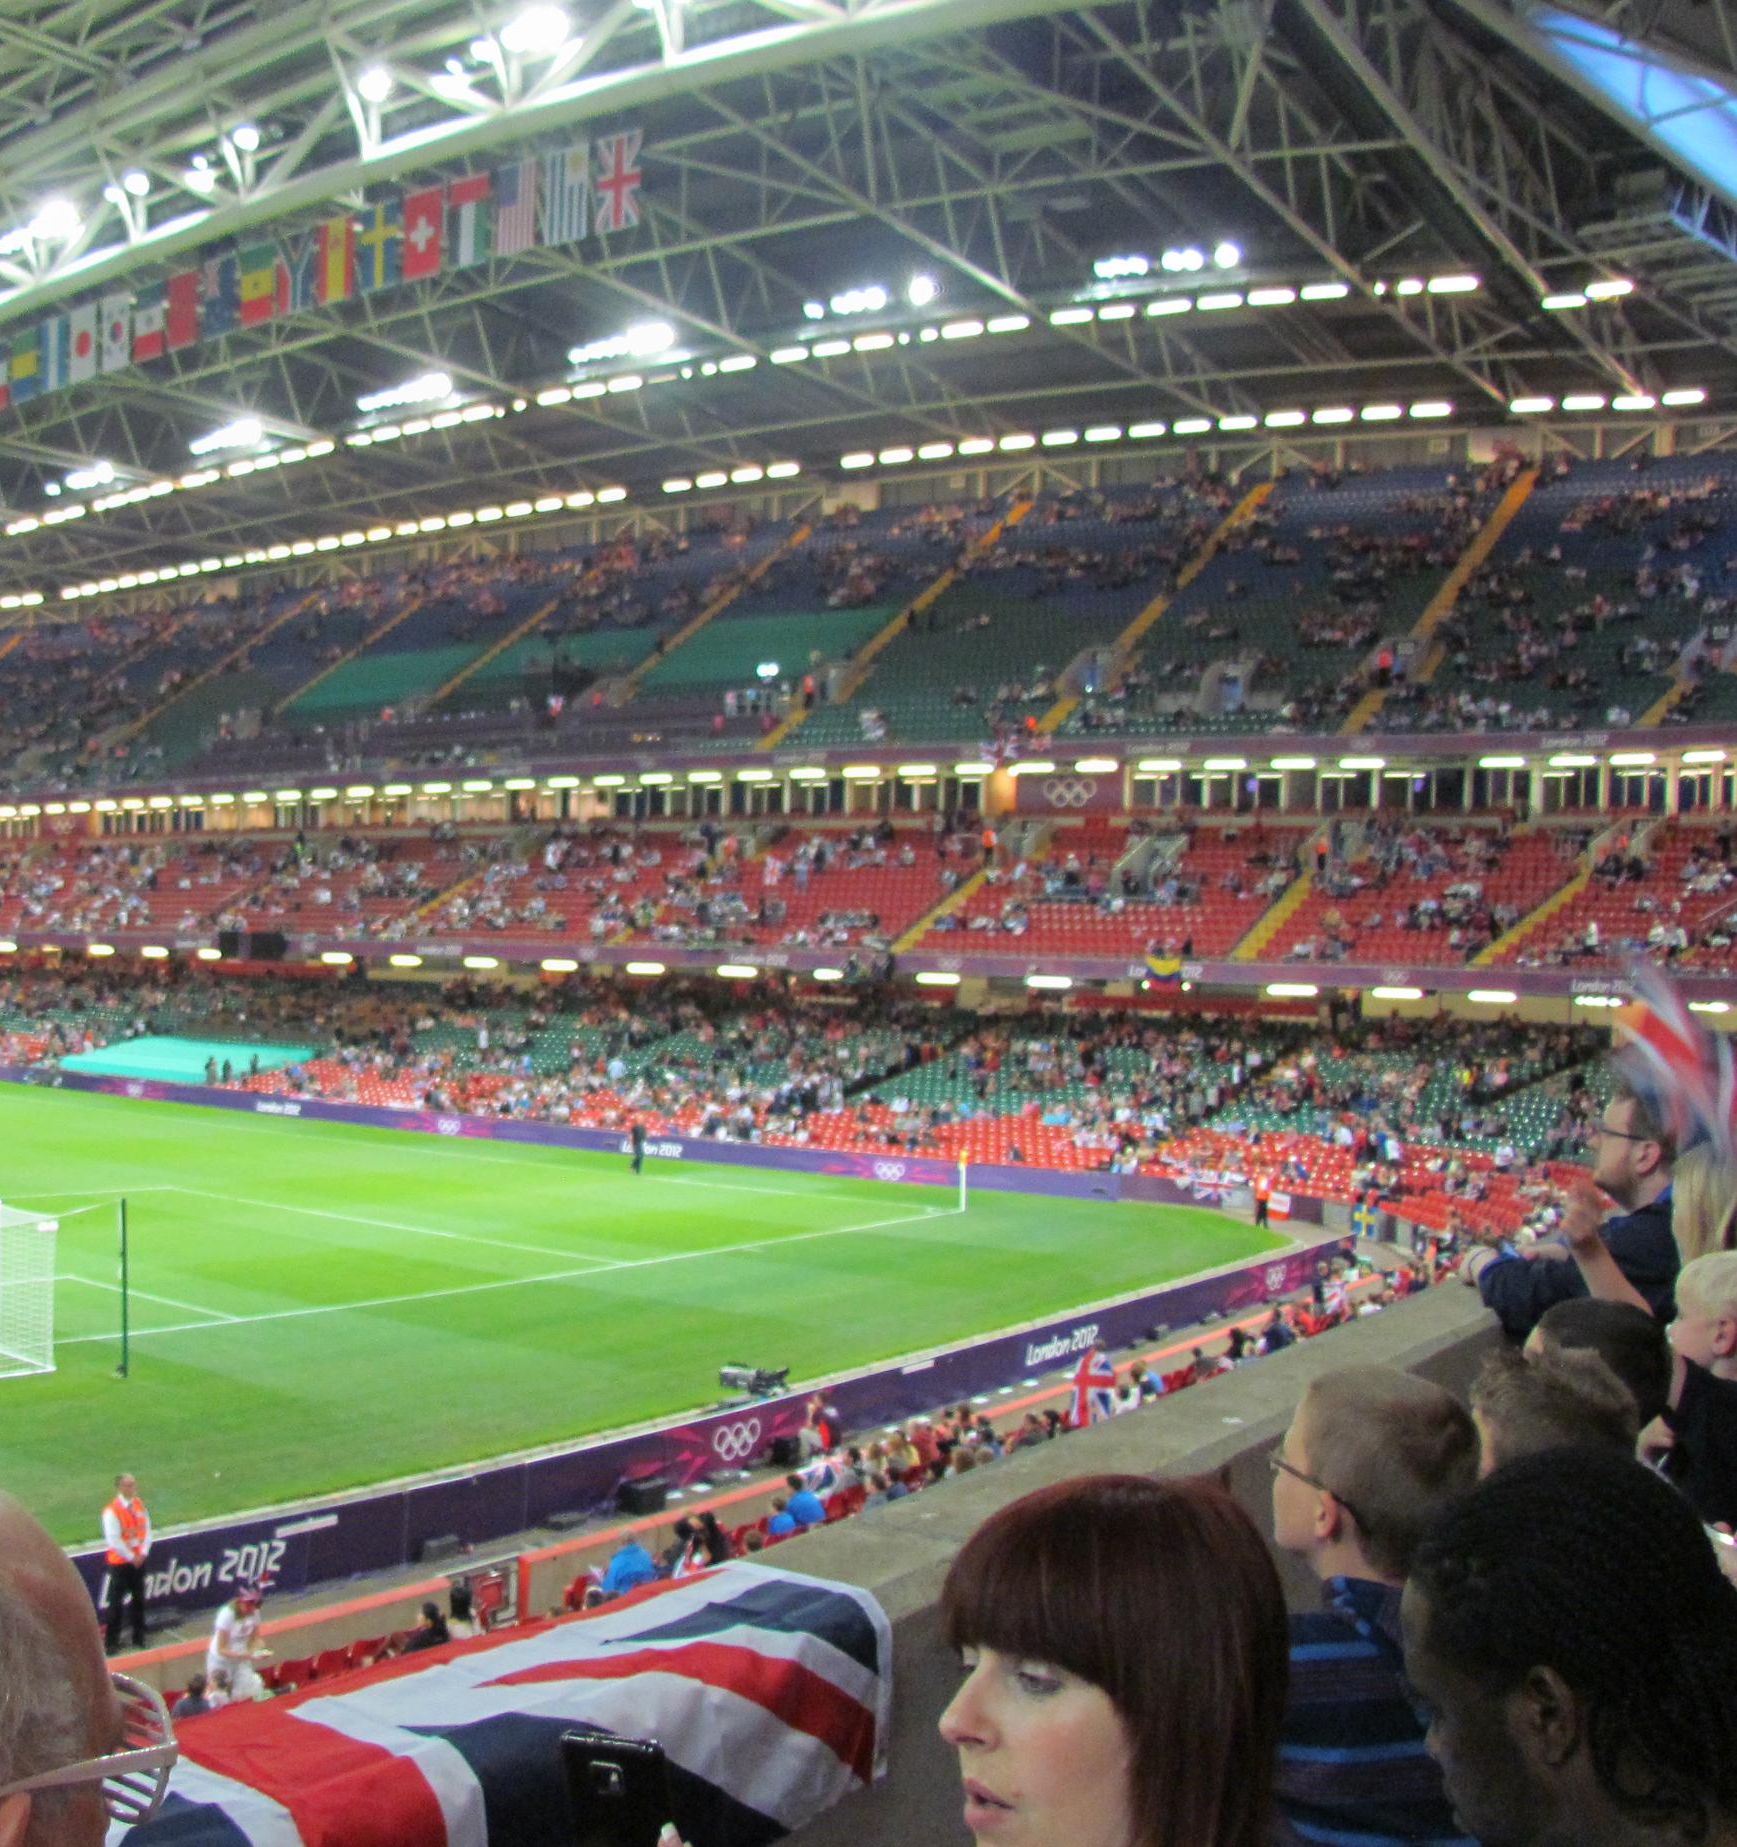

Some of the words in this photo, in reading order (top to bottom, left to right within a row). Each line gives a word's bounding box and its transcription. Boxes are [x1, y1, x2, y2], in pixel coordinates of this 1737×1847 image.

[658, 1142, 683, 1158] 2012
[1026, 1334, 1071, 1366] London
[98, 1559, 212, 1609] Lndon
[218, 1540, 286, 1586] 2012
